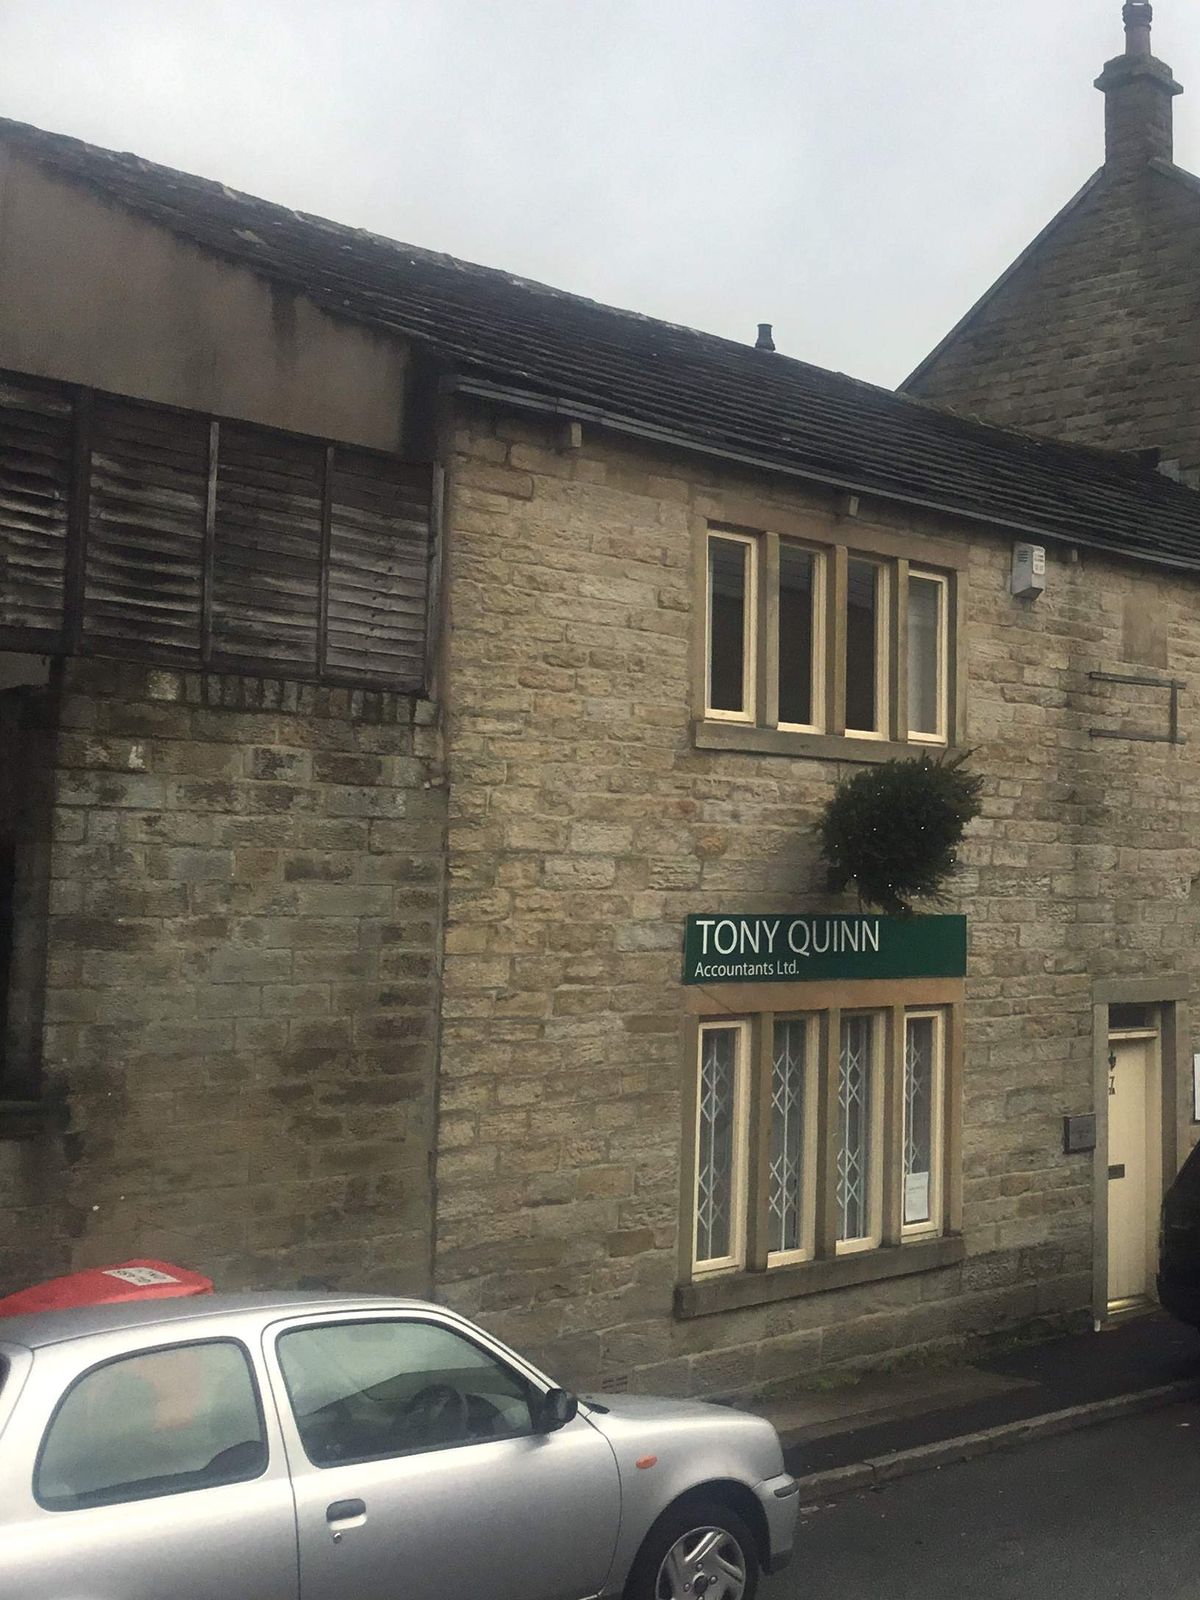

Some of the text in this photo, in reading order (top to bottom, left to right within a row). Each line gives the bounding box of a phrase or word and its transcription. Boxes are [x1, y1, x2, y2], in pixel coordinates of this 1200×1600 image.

[695, 919, 880, 957] TONY QUINN
[694, 959, 800, 977] Accountants Ltd.
